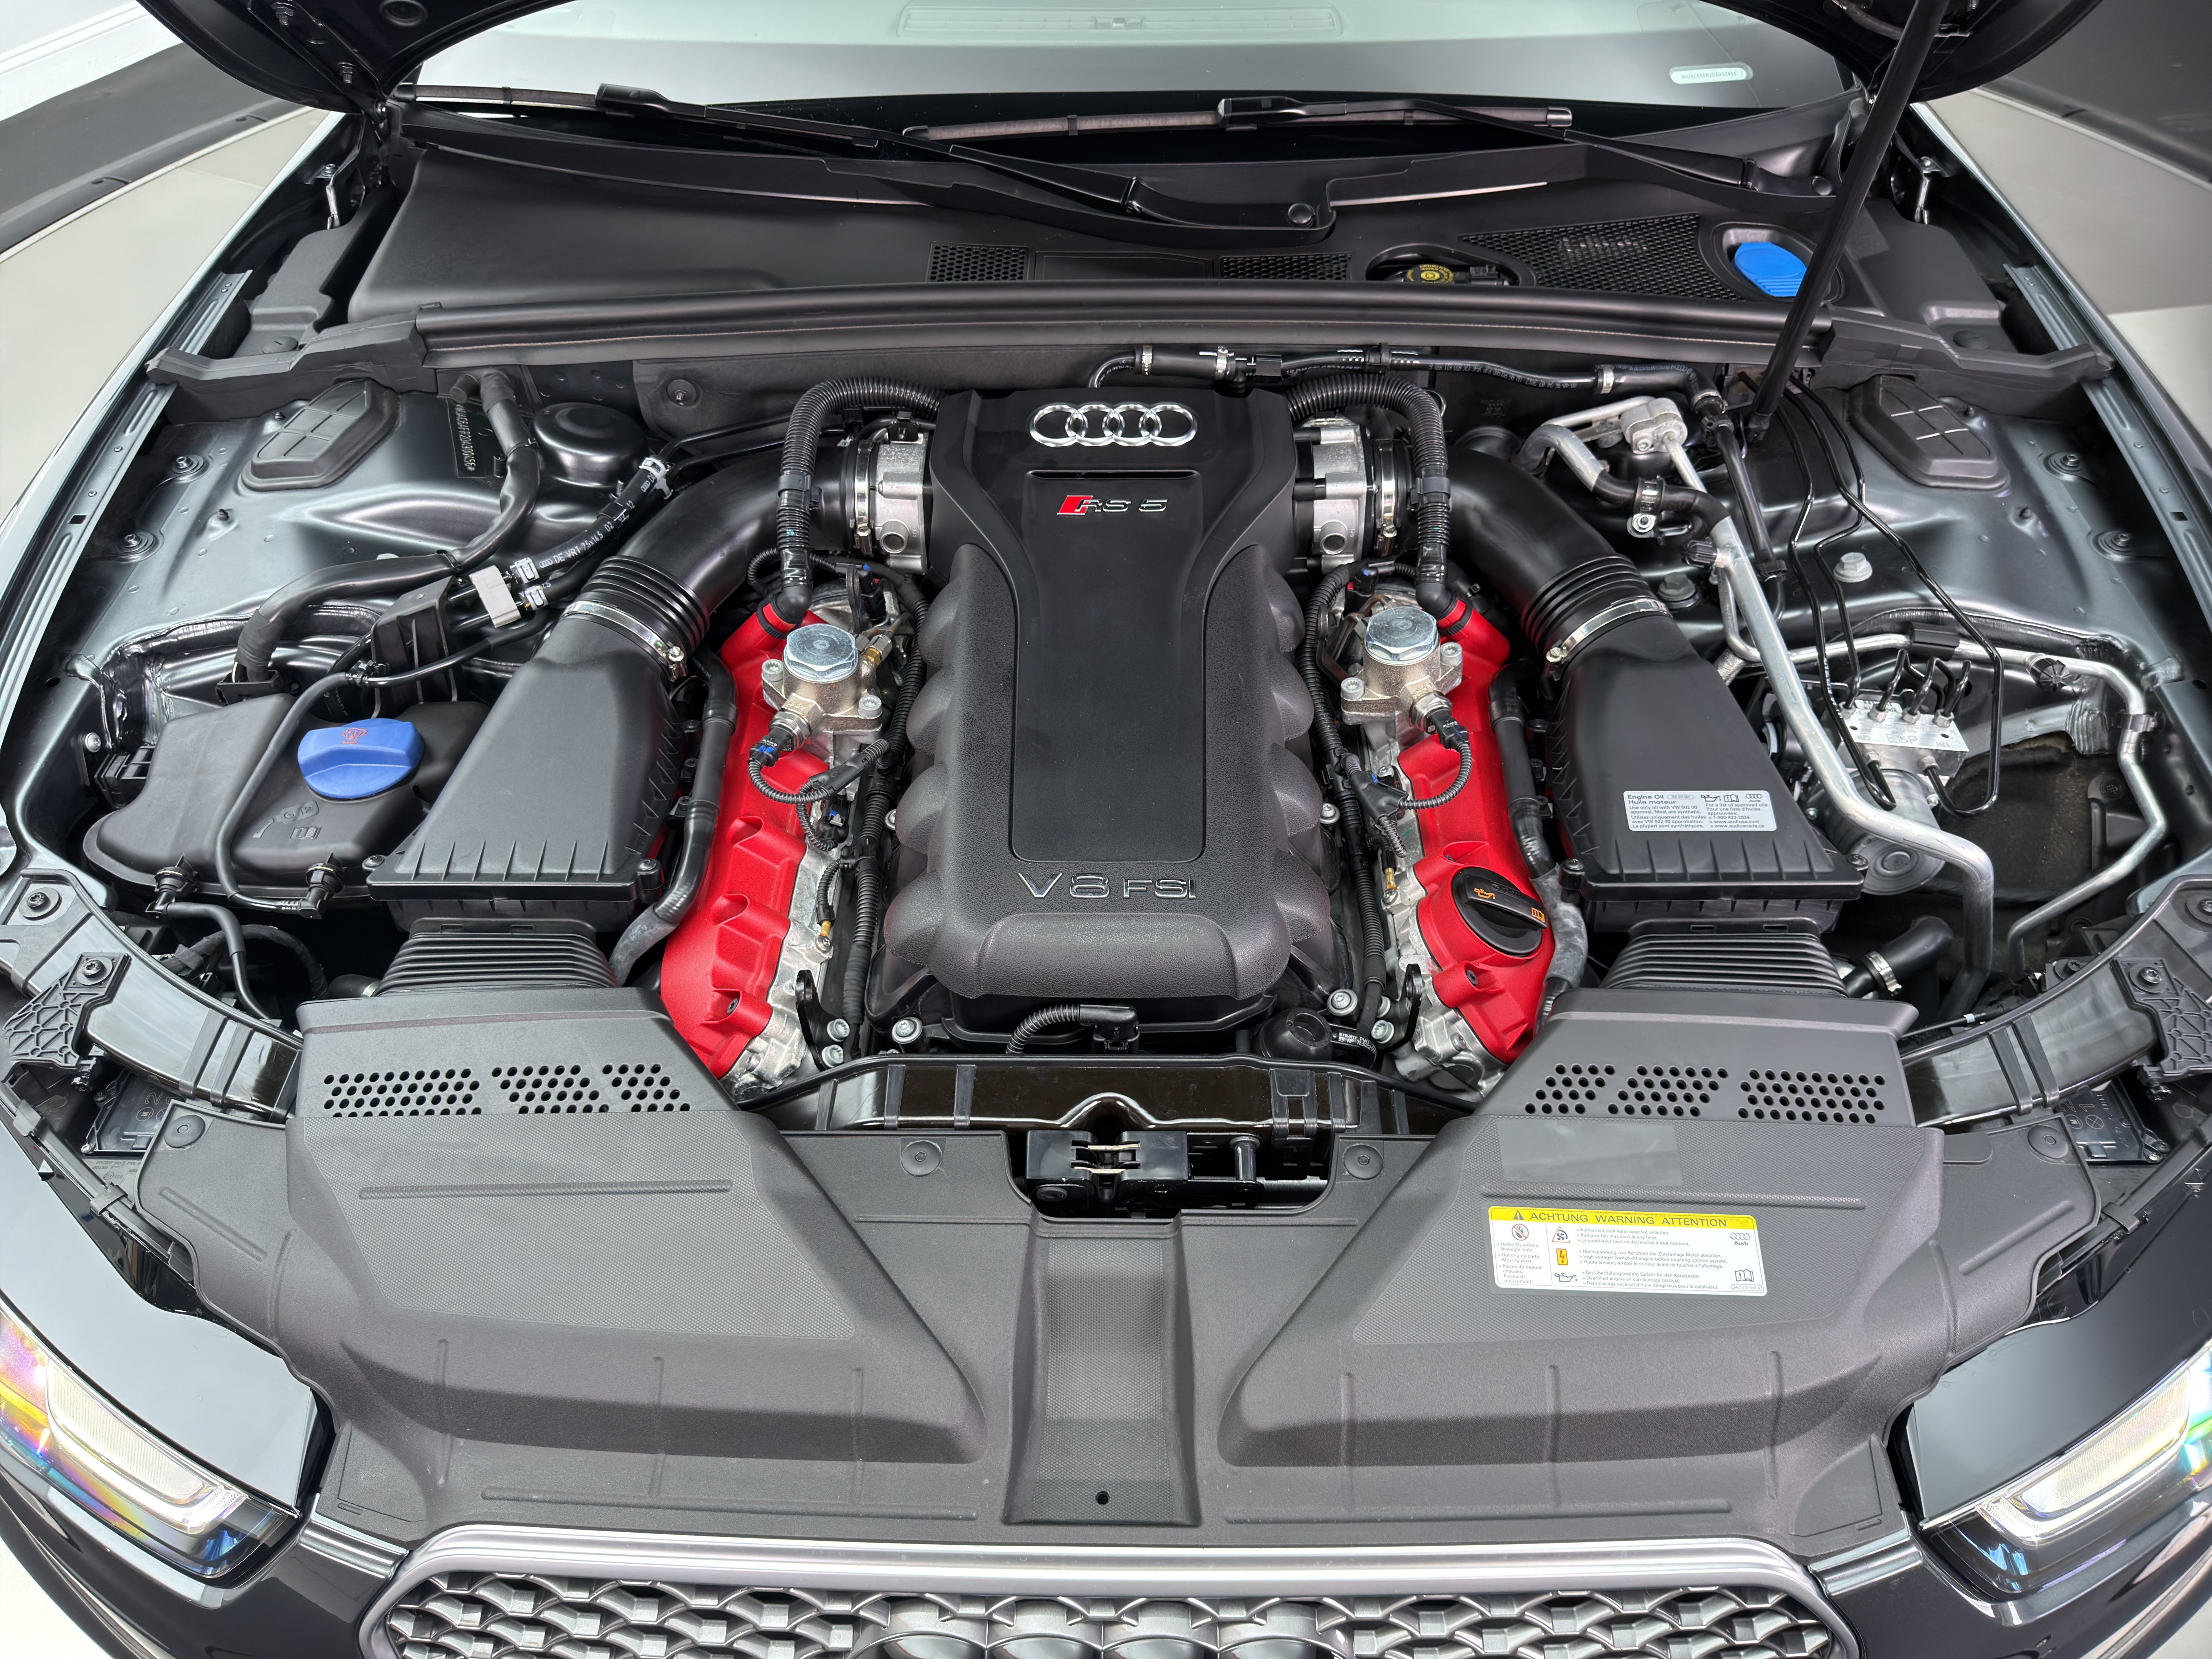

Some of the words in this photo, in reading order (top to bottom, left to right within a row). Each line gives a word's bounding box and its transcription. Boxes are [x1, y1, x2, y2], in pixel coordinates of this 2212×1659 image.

[1138, 498, 1167, 512] 5
[553, 553, 566, 564] DE
[565, 545, 581, 559] VRT
[1885, 733, 1918, 744] ESP
[1018, 872, 1110, 899] V8
[1122, 878, 1197, 900] FSI
[1530, 1213, 1588, 1222] ACHTUNG
[1595, 1215, 1654, 1224] WARNING
[1662, 1217, 1727, 1227] ATTENTION
